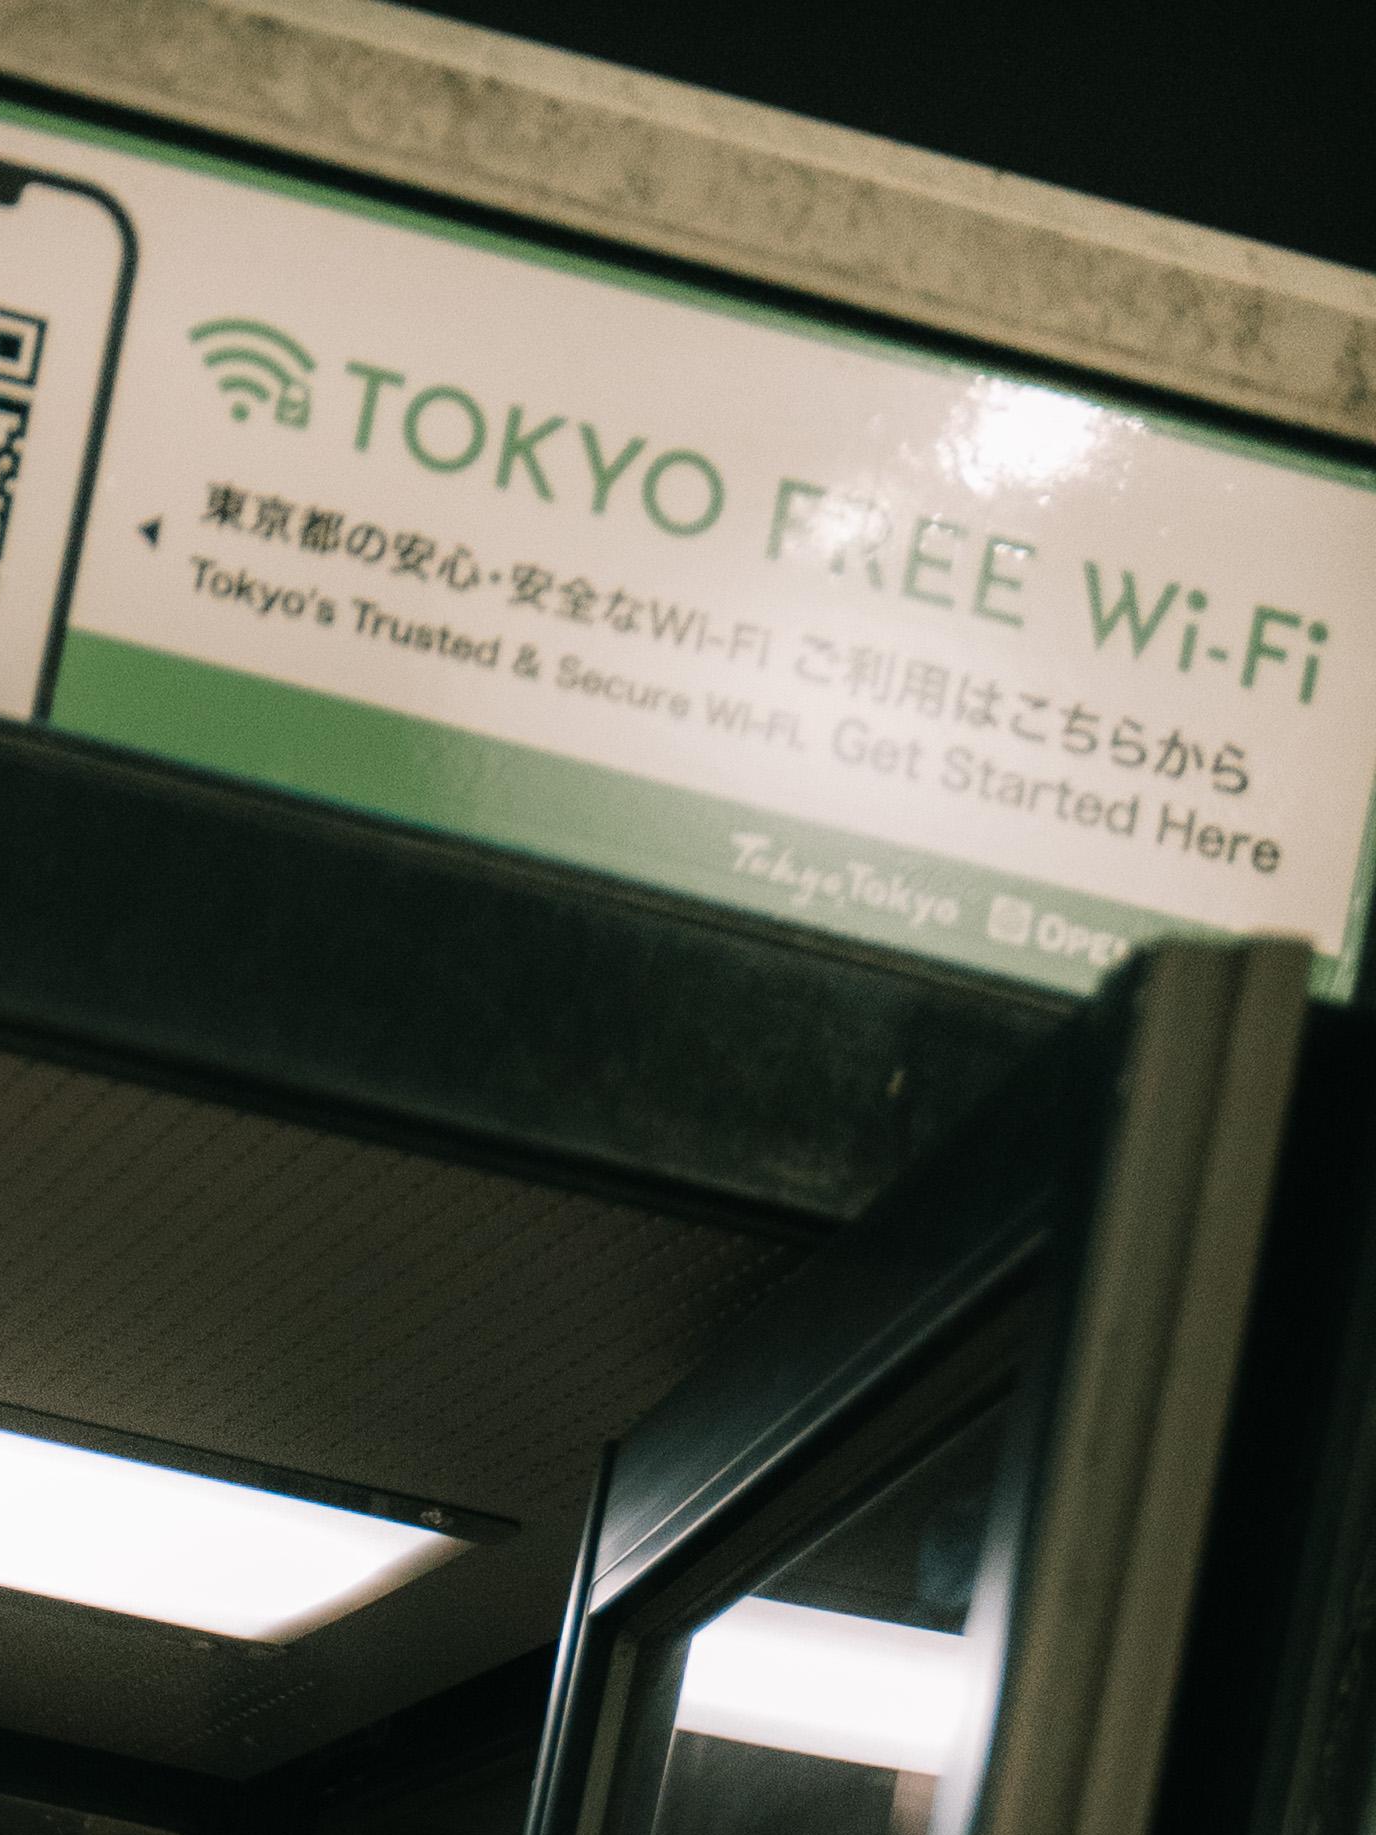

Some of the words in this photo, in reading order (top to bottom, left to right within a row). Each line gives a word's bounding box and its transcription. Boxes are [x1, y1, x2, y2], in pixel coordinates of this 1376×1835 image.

[346, 361, 725, 536] TOKYO
[1083, 560, 1328, 704] Wi-Fi
[191, 555, 334, 626] Tokyo's
[352, 599, 502, 666] Trusted
[512, 643, 540, 680] &
[555, 654, 691, 719] Secure
[831, 716, 924, 780] Get
[941, 745, 1138, 838] Started
[1156, 804, 1281, 873] Here
[1037, 913, 1130, 966] OPE
